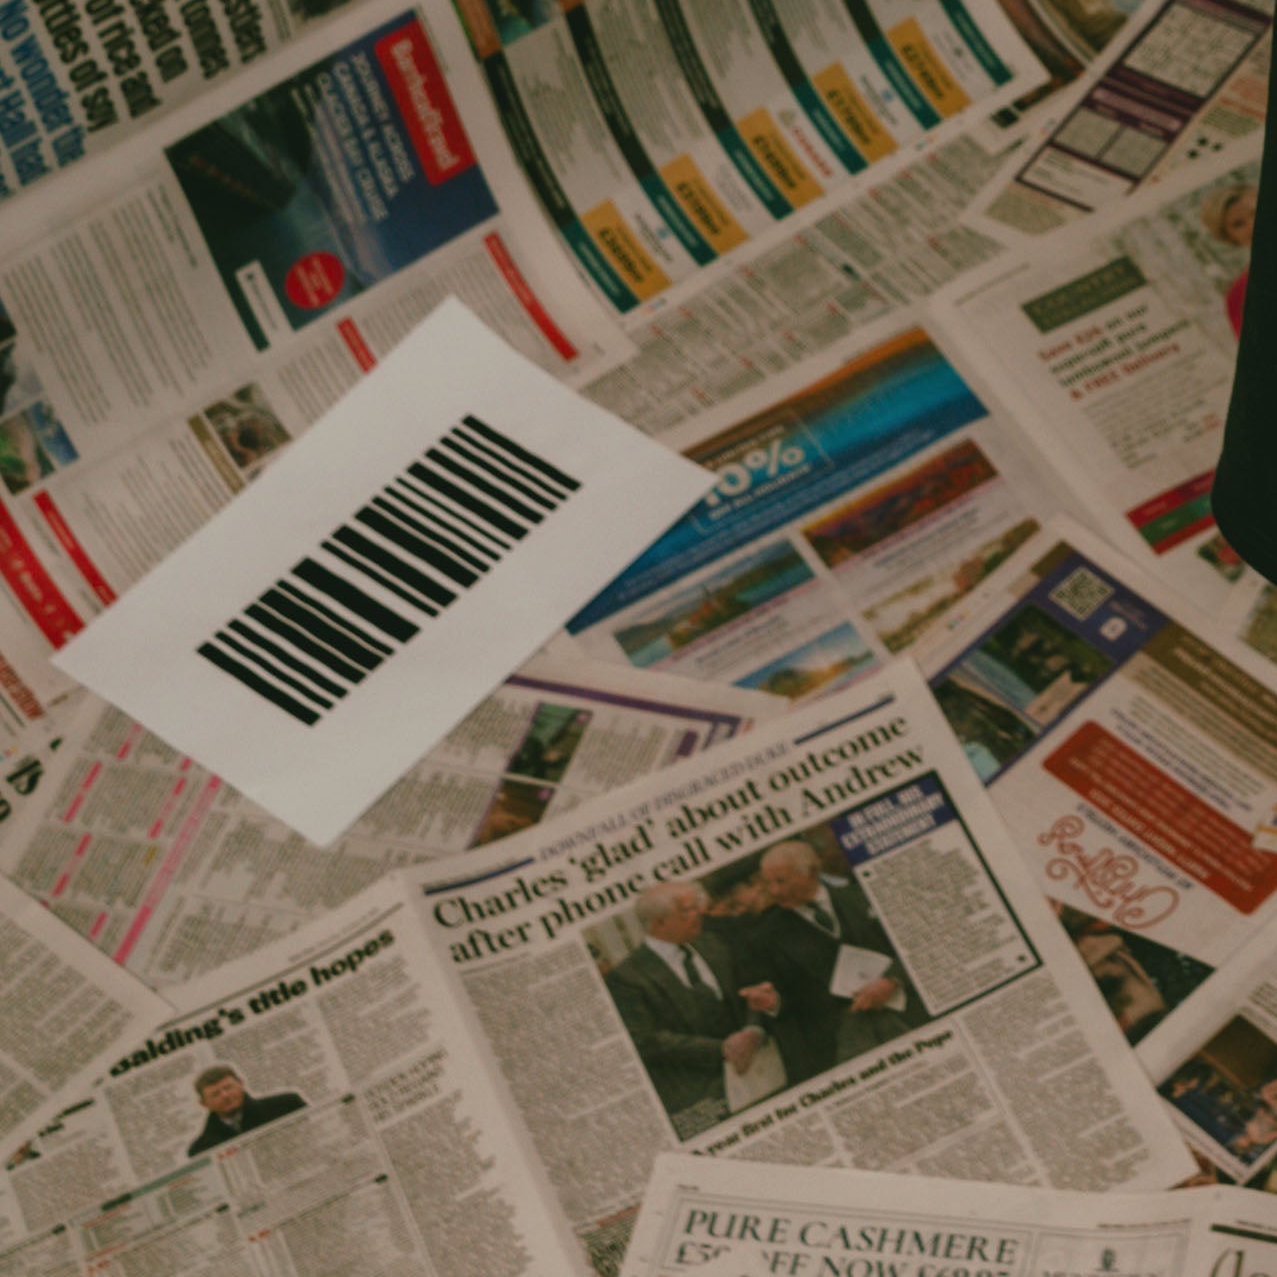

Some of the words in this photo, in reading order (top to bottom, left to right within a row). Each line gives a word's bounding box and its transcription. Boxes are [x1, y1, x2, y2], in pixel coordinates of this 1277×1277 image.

[11, 34, 73, 132] wonder
[68, 58, 108, 92] of
[98, 20, 141, 75] rice
[432, 860, 567, 928] Charles
[667, 780, 762, 838] about
[768, 718, 904, 791] outcome
[449, 922, 530, 963] after
[542, 873, 646, 937] phone
[651, 836, 711, 883] call
[715, 804, 792, 851] with
[801, 750, 922, 810] Andrew
[248, 979, 307, 1014] title
[309, 930, 394, 986] hopes
[683, 1209, 780, 1243] PURE
[798, 1225, 1007, 1263] CASHMERE
